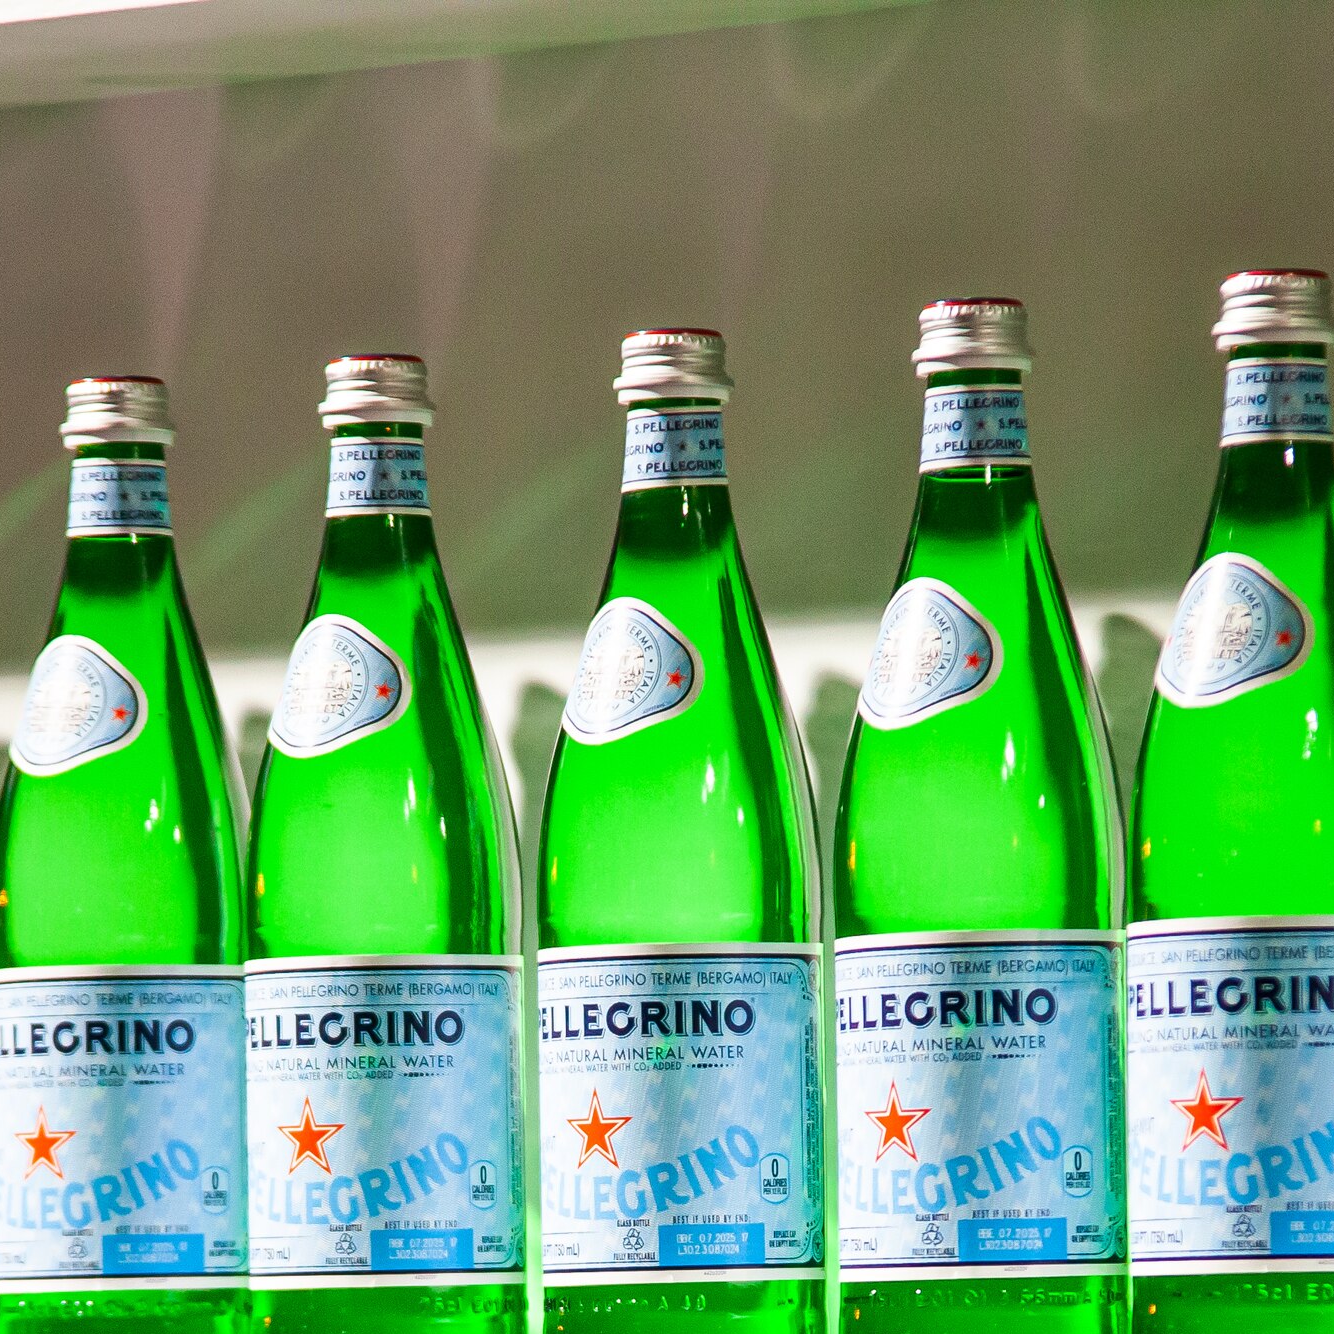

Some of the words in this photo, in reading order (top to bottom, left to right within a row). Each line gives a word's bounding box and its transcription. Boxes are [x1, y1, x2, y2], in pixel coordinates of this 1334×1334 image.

[1186, 946, 1261, 963] PELLEGRINO
[1265, 945, 1308, 960] TERME
[877, 961, 946, 977] PELLEGRINO
[950, 960, 992, 974] TERME
[997, 959, 1069, 977] (BERGAMO)
[579, 972, 646, 988] PELLEGRINO
[651, 971, 692, 986] TERME
[697, 971, 767, 989] (BERGAMO)
[769, 971, 793, 986] ITALY
[291, 983, 360, 999] PELLEGRINO
[363, 982, 403, 997] TERME
[408, 981, 476, 998] (BERGAMO)
[835, 987, 1058, 1034] ELLEGRINO
[246, 1009, 465, 1048] ELLEGRINO
[538, 999, 756, 1042] ELLEGRINO
[1157, 1026, 1218, 1041] NATURAL
[1224, 1024, 1300, 1038] MINERAL
[853, 1038, 906, 1054] NATURAL
[912, 1036, 985, 1051] MINERAL
[992, 1035, 1047, 1049] WATER
[267, 1057, 323, 1071] NATURAL
[327, 1055, 396, 1070] MINERAL
[403, 1054, 454, 1068] WATER
[556, 1048, 607, 1063] NATURAL
[614, 1046, 685, 1061] MINERAL
[691, 1045, 745, 1060] WATER
[60, 1064, 128, 1078] MINERAL
[134, 1062, 186, 1076] WATER
